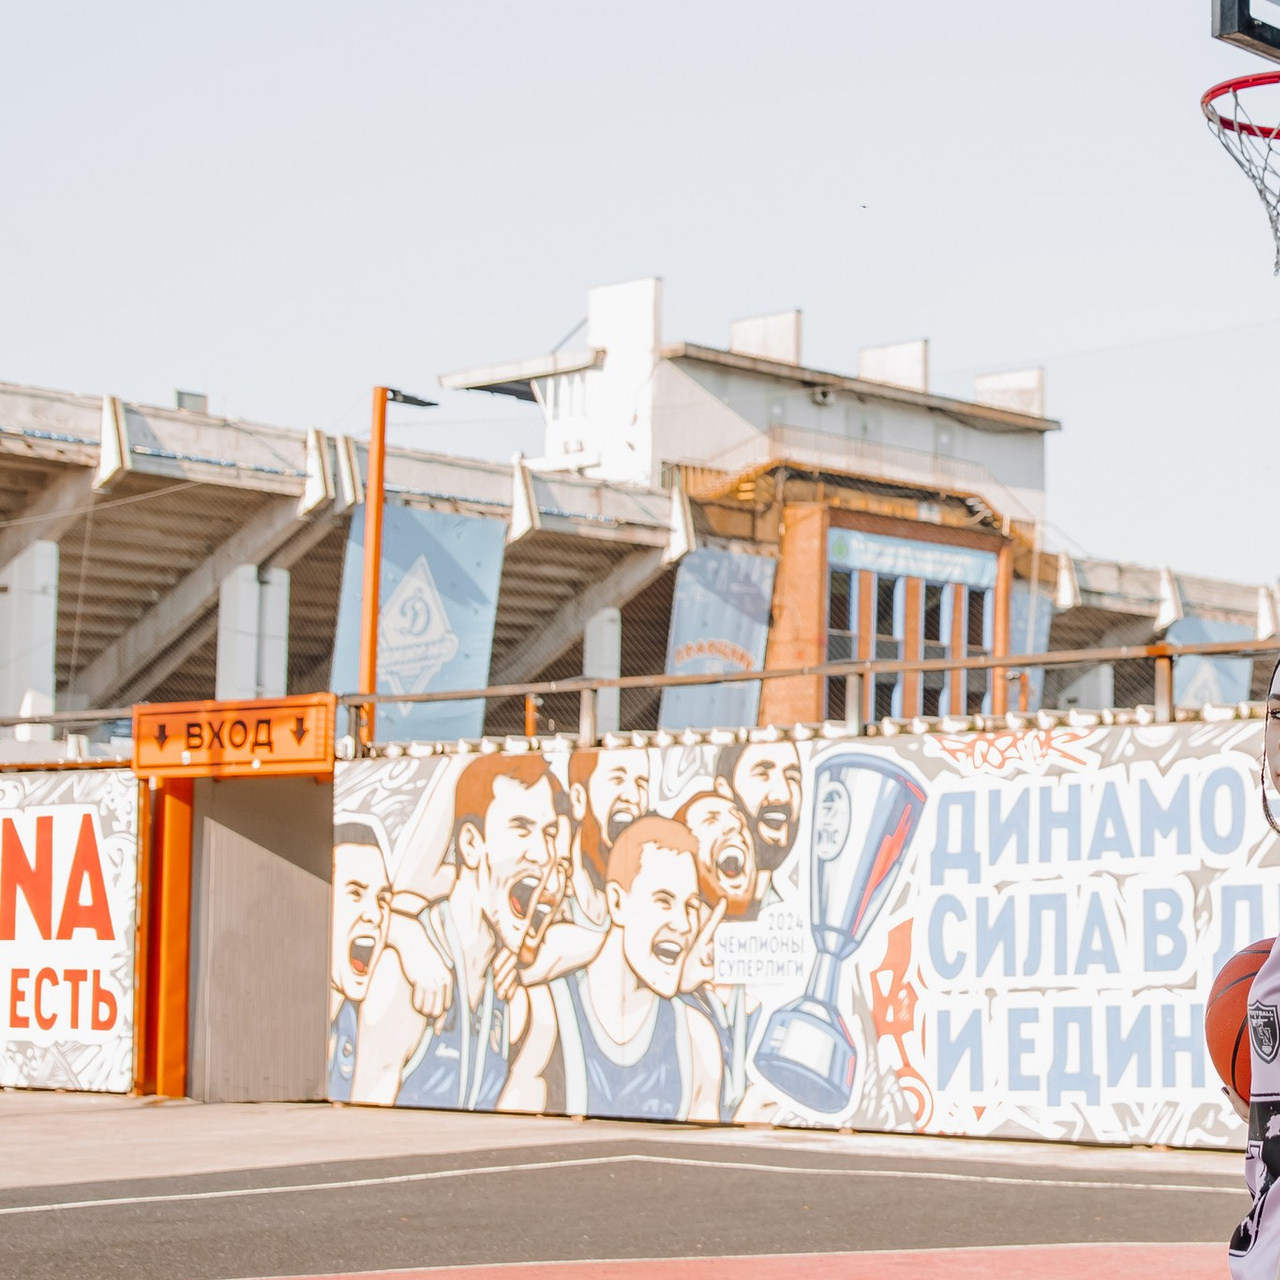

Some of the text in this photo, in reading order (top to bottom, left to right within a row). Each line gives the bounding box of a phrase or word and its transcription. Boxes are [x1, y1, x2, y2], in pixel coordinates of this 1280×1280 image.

[186, 718, 274, 754] ВХОД
[929, 766, 1247, 886] ДИНАМО
[718, 935, 805, 954] ЧЕМПИОНЫ
[768, 912, 804, 931] 2024
[928, 891, 1121, 980] СИЛА
[1142, 888, 1188, 973] В
[718, 959, 805, 977] СУПЕРЛИГИ
[9, 967, 118, 1031] ЕСТЬ
[936, 1004, 1206, 1107] И ЕДИН
